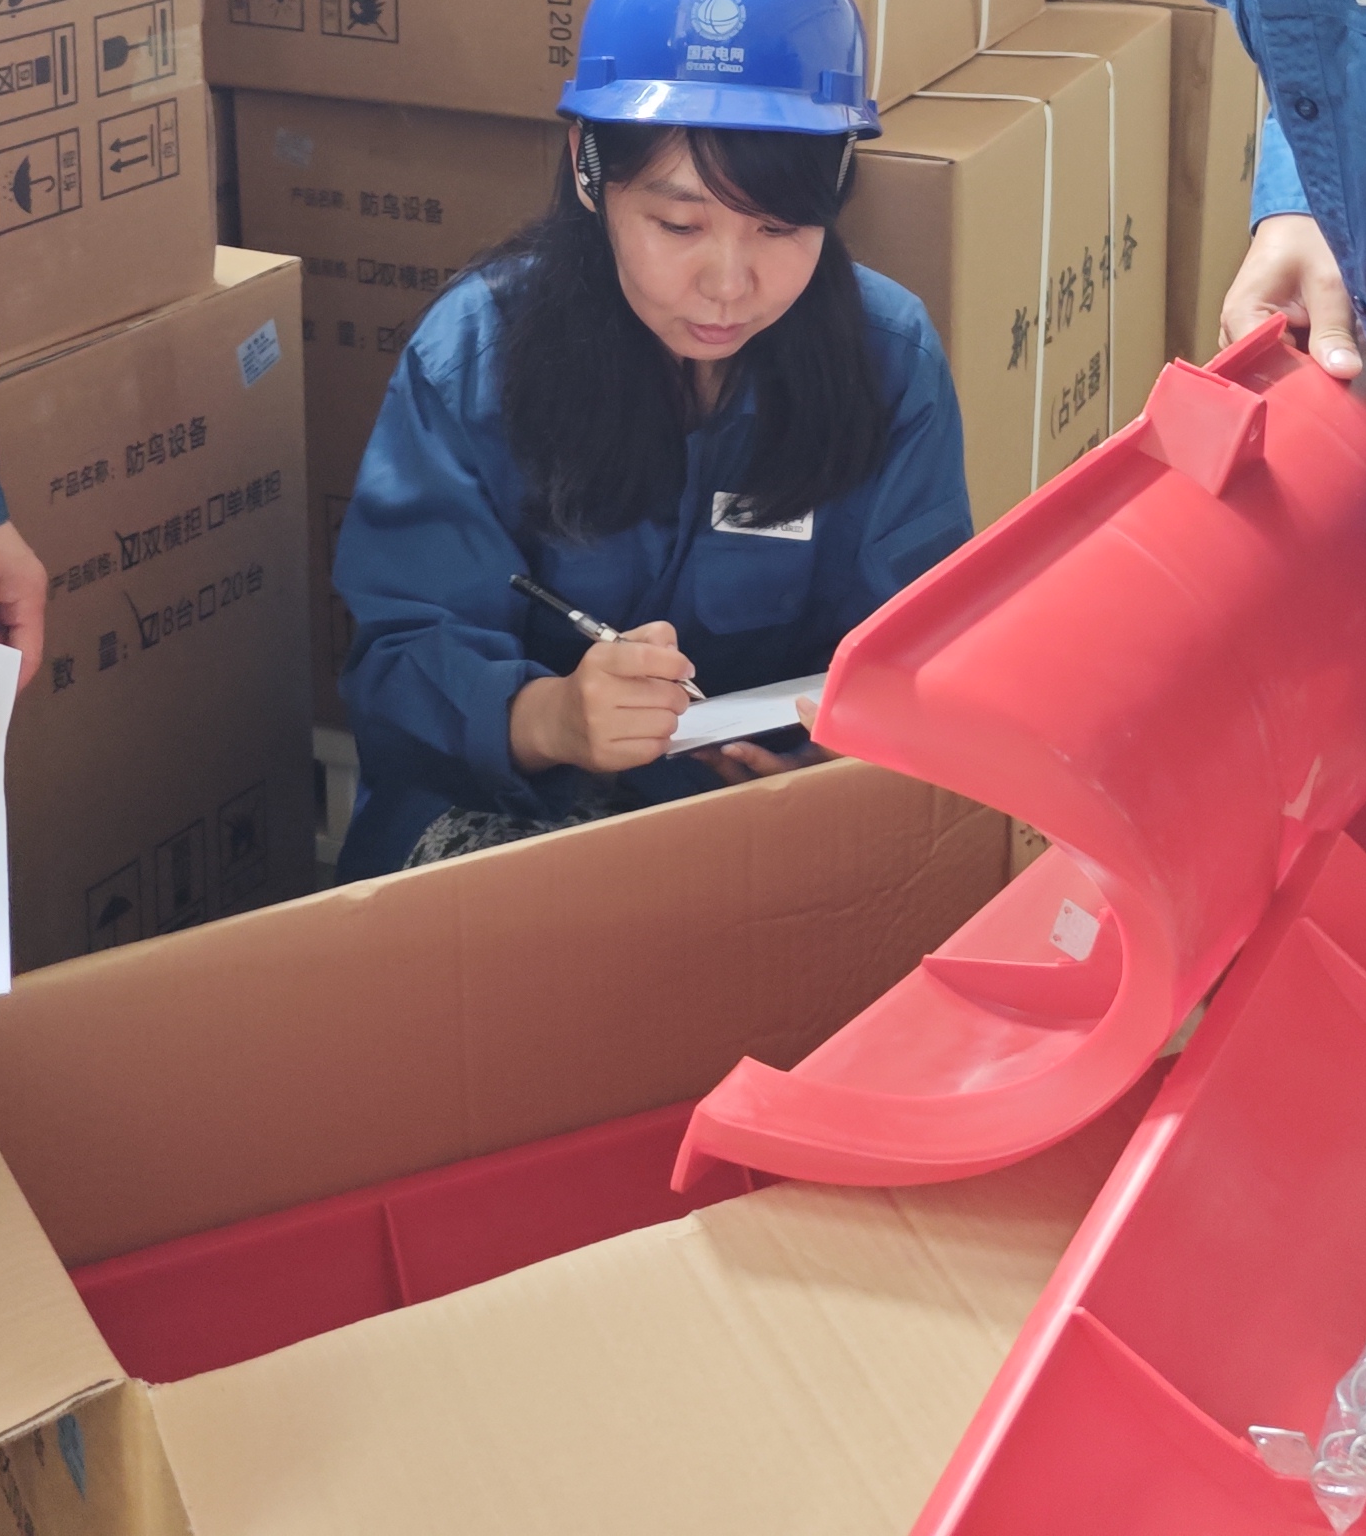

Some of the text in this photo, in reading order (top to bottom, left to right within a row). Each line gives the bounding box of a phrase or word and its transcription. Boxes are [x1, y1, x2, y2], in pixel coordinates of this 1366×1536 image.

[548, 9, 573, 68] 20台
[686, 45, 745, 63] 国家电网
[162, 117, 176, 159] 向上
[63, 150, 77, 192] 怕雨
[360, 190, 443, 225] 防鸟设备
[49, 415, 207, 507] 产品名称： 防鸟设备
[142, 505, 203, 561] 双横担
[226, 469, 282, 518] 单横担
[162, 599, 193, 637] 8台
[220, 564, 265, 608] 20台
